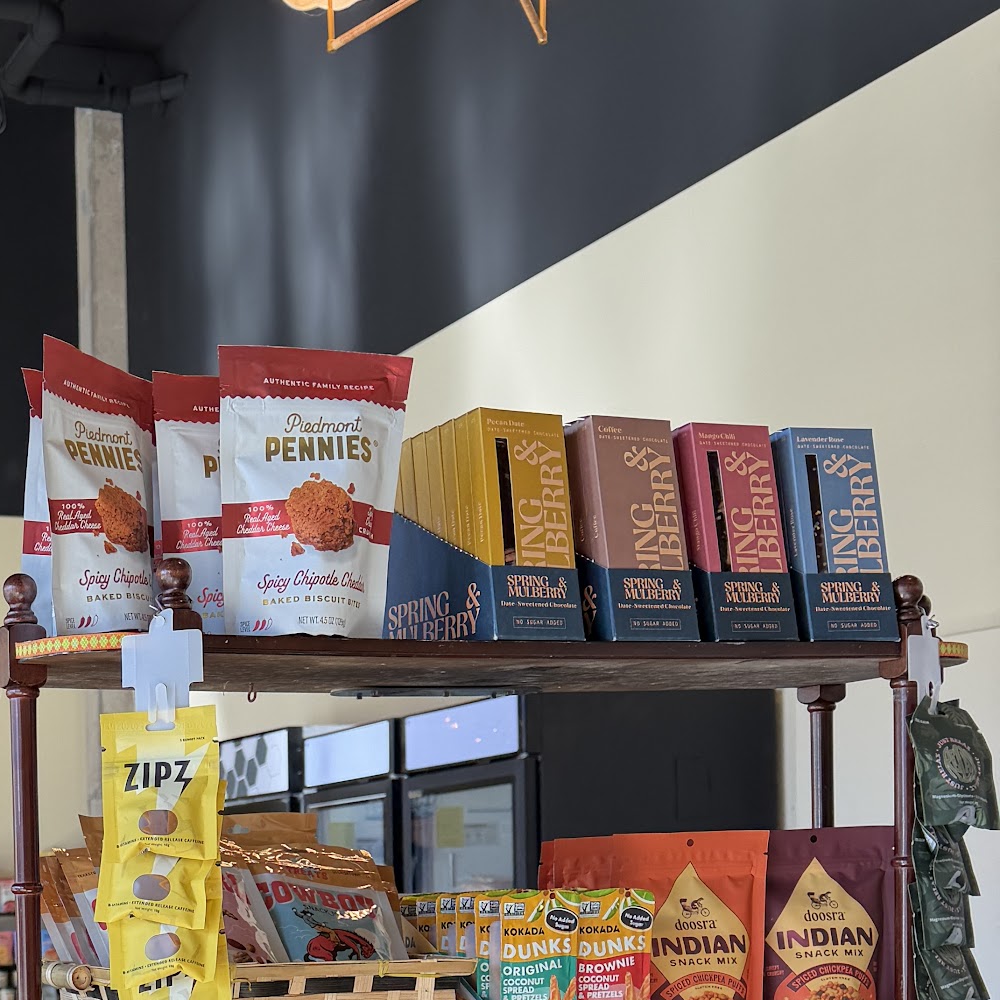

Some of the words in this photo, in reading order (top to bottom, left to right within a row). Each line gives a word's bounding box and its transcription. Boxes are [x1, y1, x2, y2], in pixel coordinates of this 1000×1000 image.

[263, 377, 310, 389] AUTHENTIC
[312, 381, 342, 391] FAMILY
[343, 384, 375, 392] RECIPE
[284, 412, 363, 434] Piedmont
[598, 425, 622, 433] Coffee
[74, 420, 132, 446] Piedmont
[265, 434, 373, 463] PENNIES
[64, 439, 143, 473] PENNIES
[248, 505, 274, 513] 100%
[244, 513, 263, 524] Real
[263, 511, 281, 525] Aged
[236, 523, 266, 535] Cheddar
[266, 519, 290, 532] Cheese
[79, 569, 111, 591] Spicy
[113, 567, 149, 589] Chipotle
[257, 573, 291, 594] Spicy
[293, 568, 339, 590] Chipotle
[507, 575, 549, 588] SPRING
[558, 576, 567, 588] &
[623, 577, 663, 589] SPRING
[673, 579, 681, 589] &
[508, 586, 568, 599] MULBERRY
[724, 581, 763, 592] SPRING
[772, 582, 780, 593] &
[821, 581, 862, 592] SPRING
[871, 582, 880, 592] &
[86, 593, 123, 603] BAKED
[262, 596, 300, 606] BAKED
[304, 595, 346, 604] BISCUIT
[625, 589, 682, 600] MULBERRY
[725, 592, 781, 603] MULBERRY
[822, 591, 881, 603] MULBERRY
[387, 590, 450, 631] SPRING
[465, 582, 481, 610] &
[124, 760, 193, 795] ZIPZ
[803, 910, 845, 922] doosra
[579, 925, 620, 935] KOKADA
[675, 919, 716, 931] doosra
[504, 927, 545, 937] KOKADA
[776, 927, 873, 950] INDIAN
[503, 938, 571, 960] DUNKS
[579, 935, 646, 957] DUNKS
[652, 934, 746, 957] INDIAN
[795, 950, 838, 959] SNACK
[844, 949, 864, 957] MIX
[503, 959, 563, 976] ORIGINAL
[578, 956, 635, 973] BROWNIE
[670, 958, 711, 967] SNACK
[717, 957, 737, 965] MIX
[503, 978, 545, 986] COCONUT
[578, 975, 620, 983] COCONUT
[792, 970, 818, 989] SPICED
[819, 965, 854, 975] CHICKPEA
[503, 986, 535, 995] SPREAD
[578, 983, 610, 991] SPREAD
[666, 978, 691, 998] SPICED
[693, 975, 726, 985] CHICKPEA
[586, 990, 623, 999] PRETZELS
